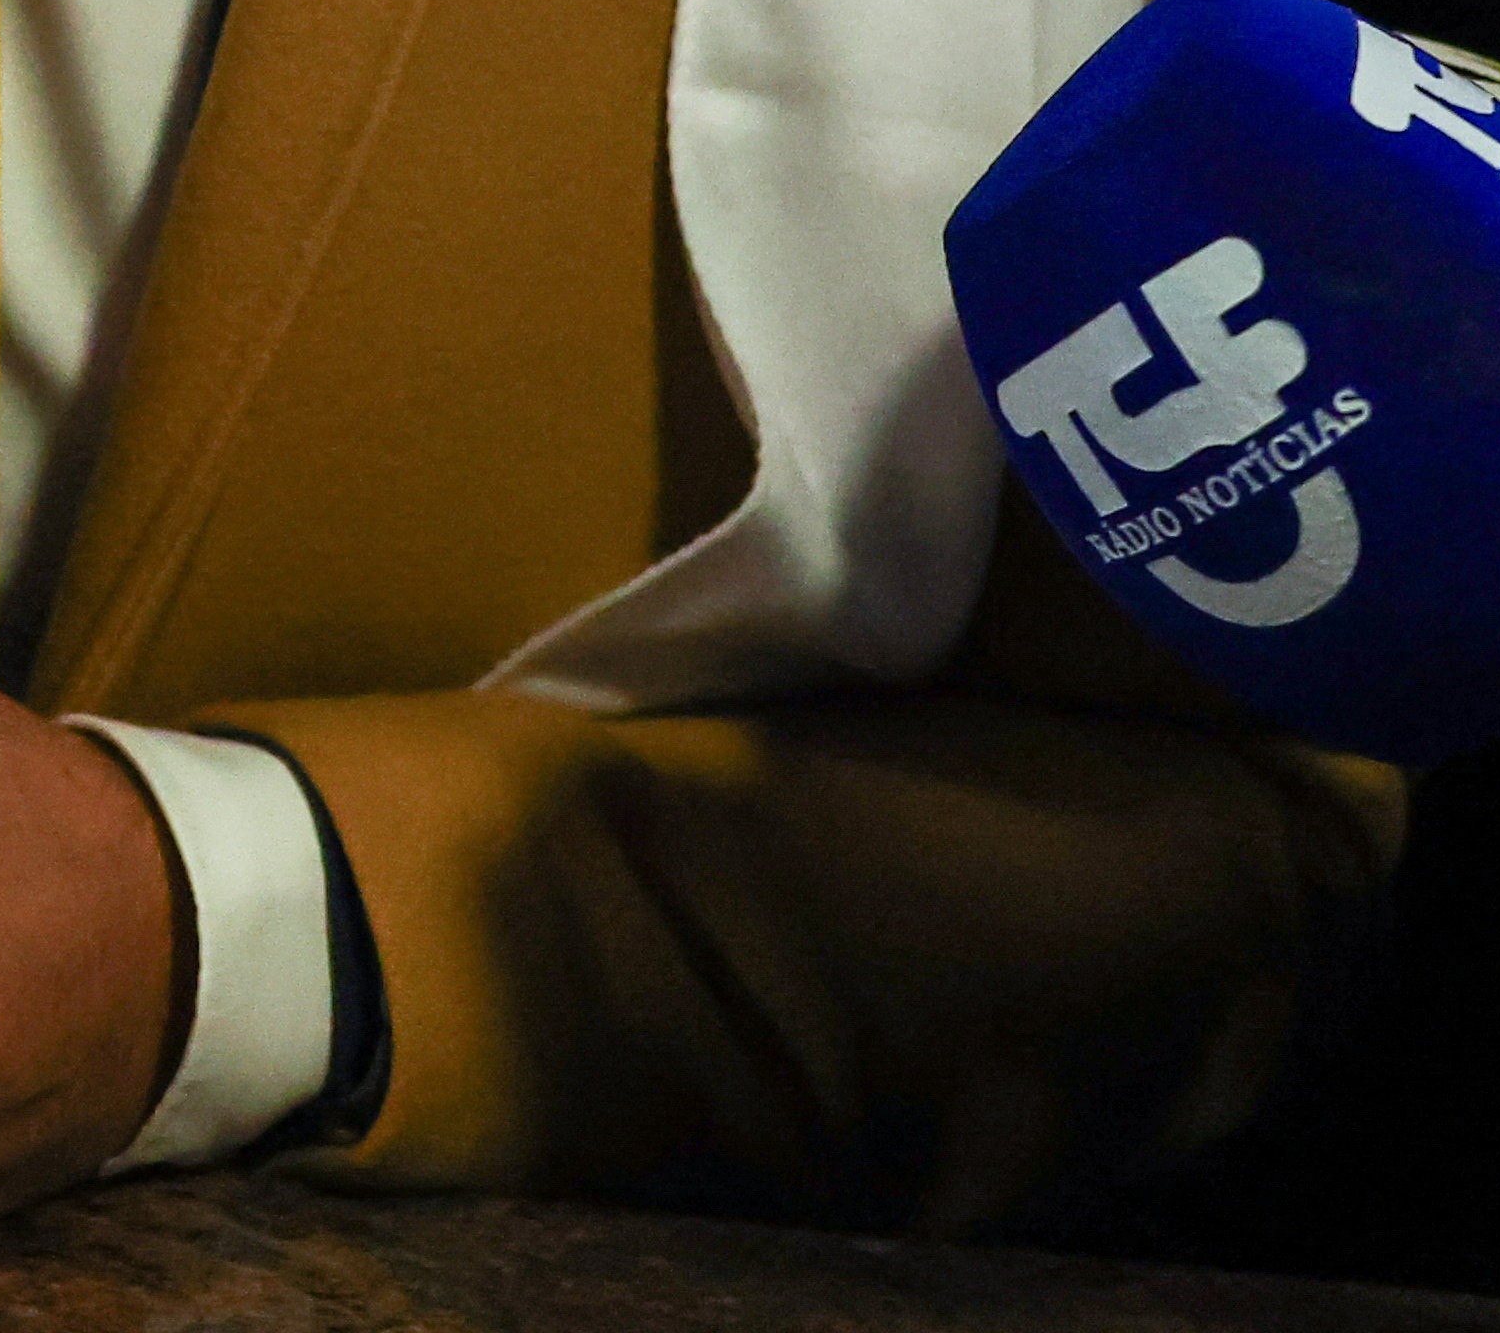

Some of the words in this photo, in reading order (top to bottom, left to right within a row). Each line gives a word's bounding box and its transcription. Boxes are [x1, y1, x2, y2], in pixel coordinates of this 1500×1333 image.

[996, 236, 1362, 628] TSF
[1085, 520, 1183, 564] RÁDIO
[1176, 386, 1373, 524] NOTÍCIAS
